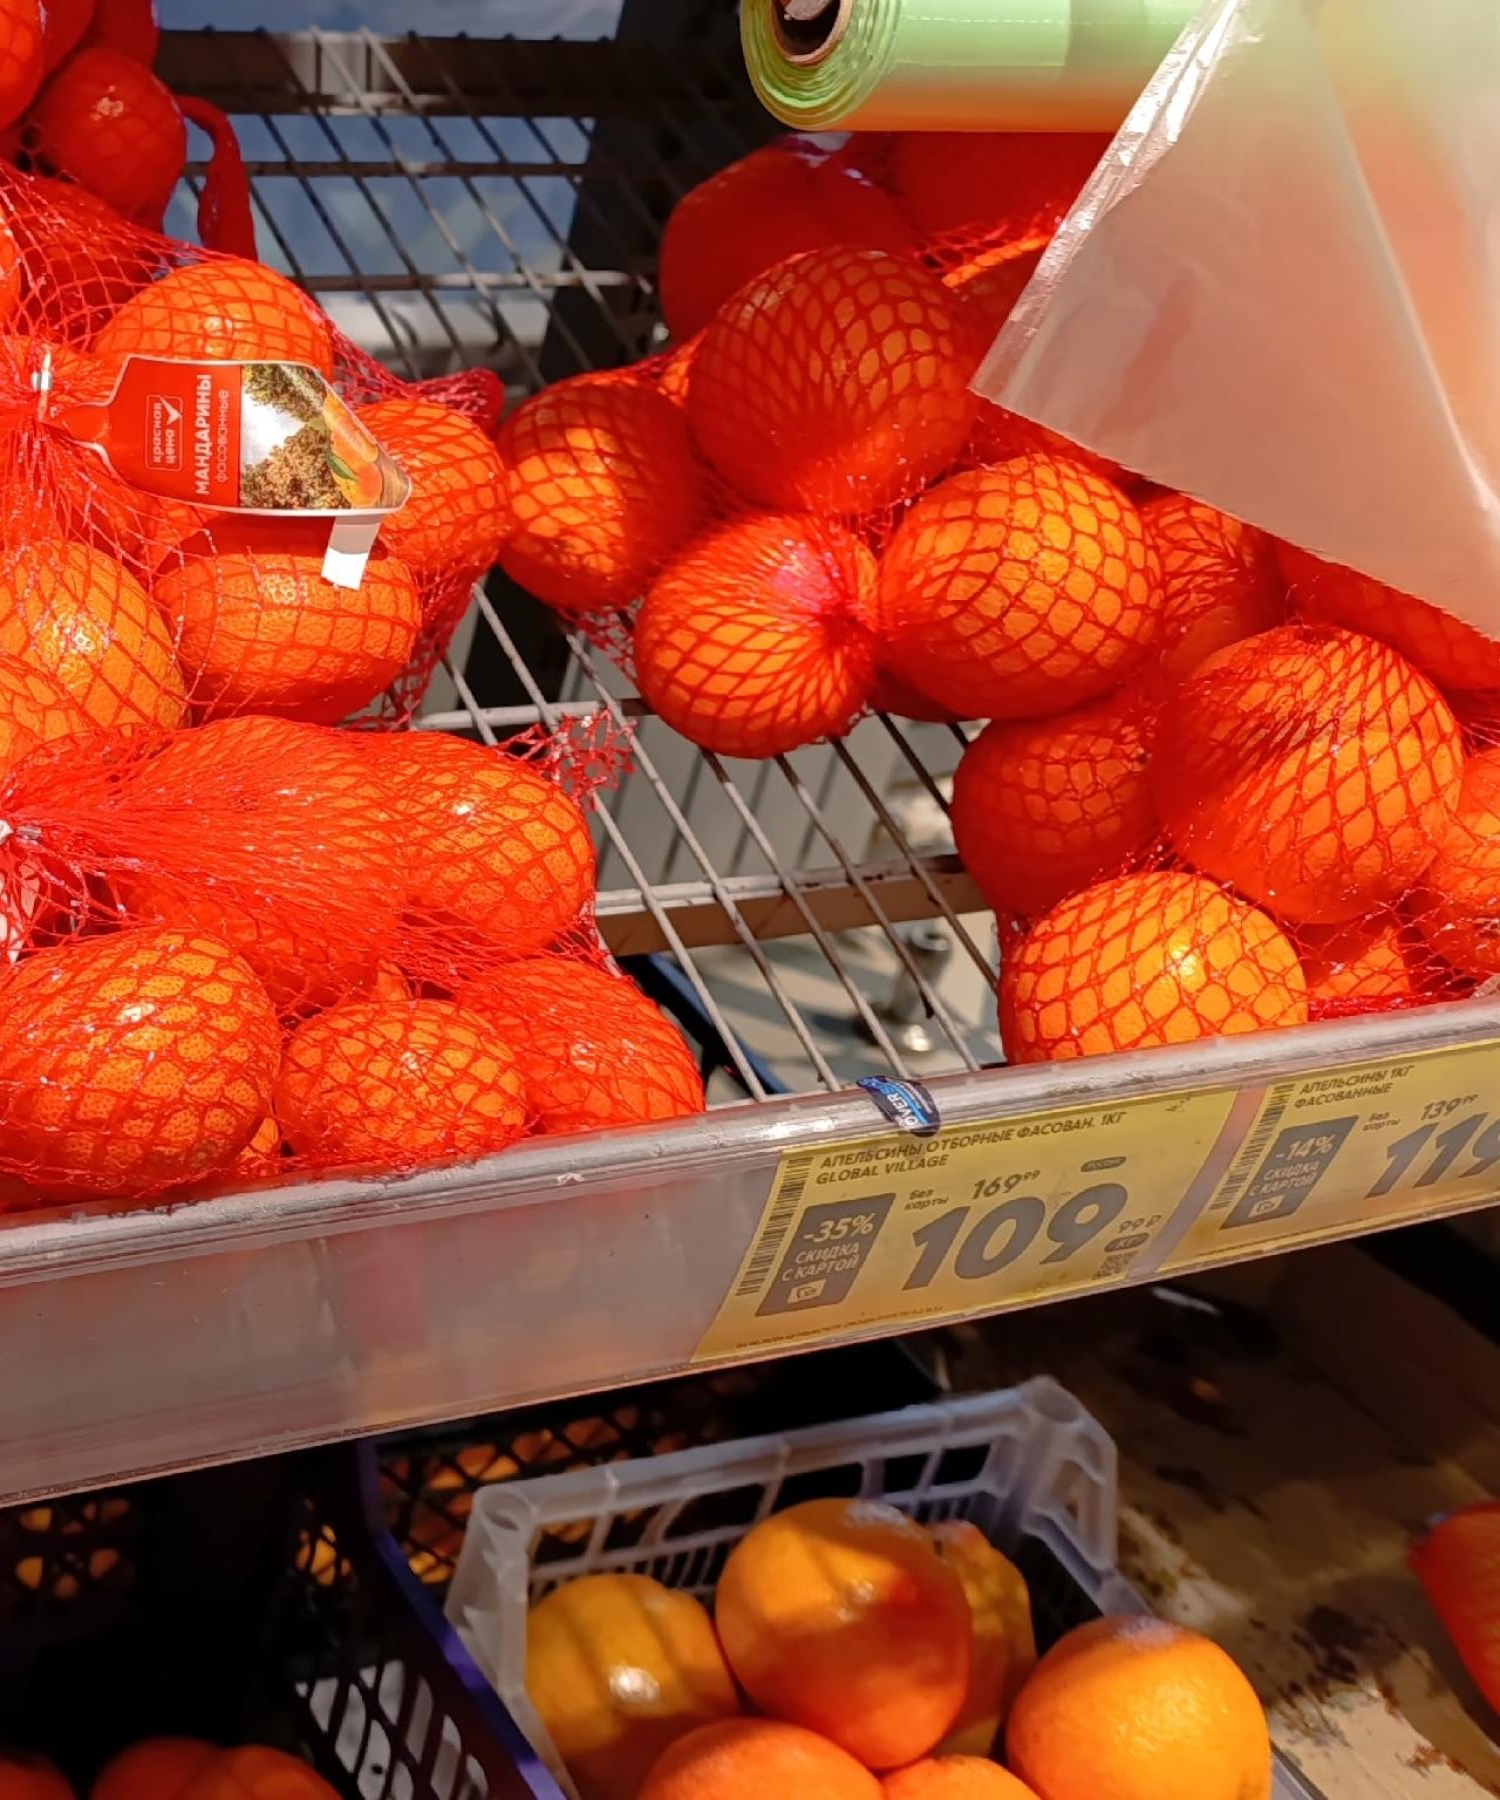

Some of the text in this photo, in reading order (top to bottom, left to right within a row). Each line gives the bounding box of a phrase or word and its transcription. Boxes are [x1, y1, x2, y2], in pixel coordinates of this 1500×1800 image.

[195, 374, 212, 495] МАНДАРИНЫ
[216, 389, 229, 482] фасованные
[1295, 1083, 1393, 1108] ФАСОВАННЫЕ
[1300, 1070, 1387, 1095] АПЕЛЬСИНЫ
[821, 1112, 1126, 1168] АПЕЛЬСИНЫ ОТБОРНЫЕ ФАСОВАН. 1КГ
[1276, 1134, 1336, 1160] -14%
[817, 1155, 949, 1185] GLOBAL VILLAGE
[1263, 1161, 1320, 1180] СКИДКА
[804, 1213, 875, 1242] -35%
[902, 1183, 1128, 1290] 109
[796, 1242, 859, 1264] СКИДКА
[782, 1255, 859, 1281] С КАРТОЙ
